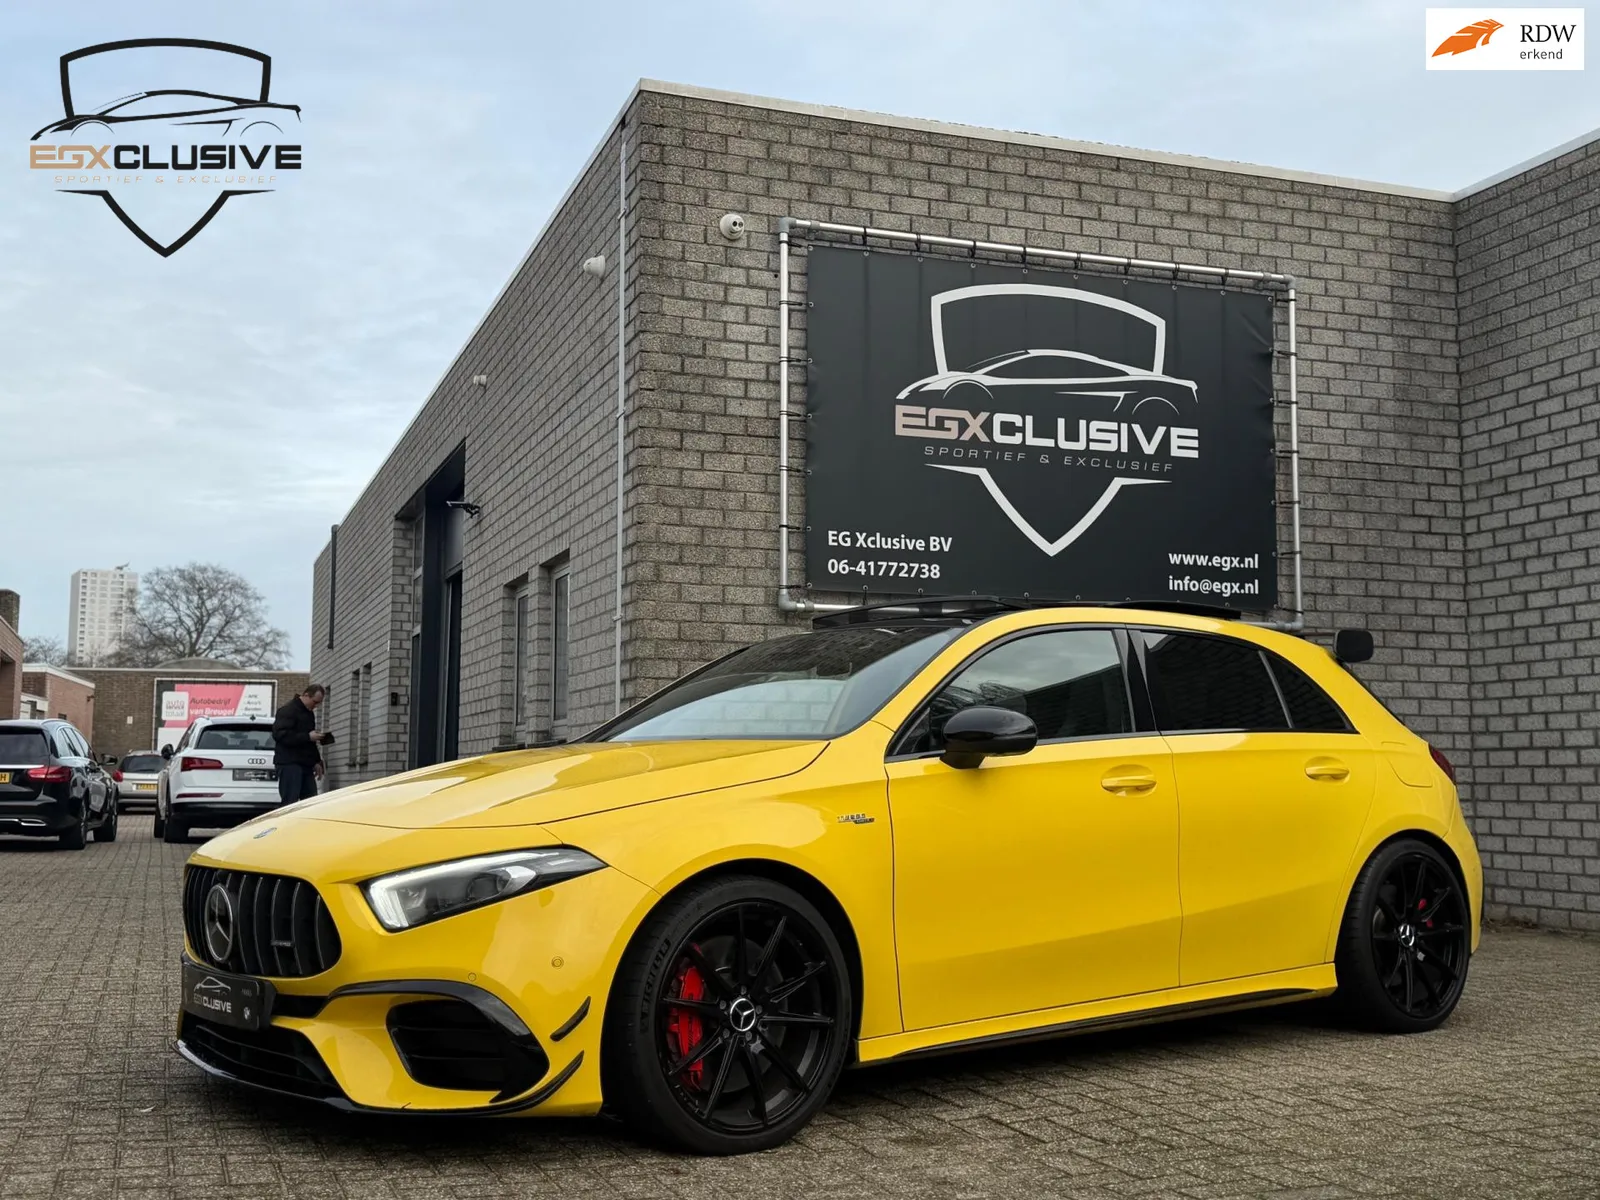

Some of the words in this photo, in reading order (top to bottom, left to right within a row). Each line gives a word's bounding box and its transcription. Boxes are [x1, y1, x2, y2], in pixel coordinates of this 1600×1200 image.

[895, 404, 1199, 459] EGXCLUSIVE
[924, 446, 1027, 462] SPORTIEF
[1039, 454, 1050, 464] &
[1064, 456, 1173, 473] EXCLUSIEF
[827, 530, 851, 547] EG
[855, 532, 926, 551] Xclusive
[929, 536, 953, 552] BV
[827, 558, 941, 579] 06-41772738
[1168, 553, 1259, 571] www.egx.nl
[1168, 575, 1259, 597] info@egx.nl
